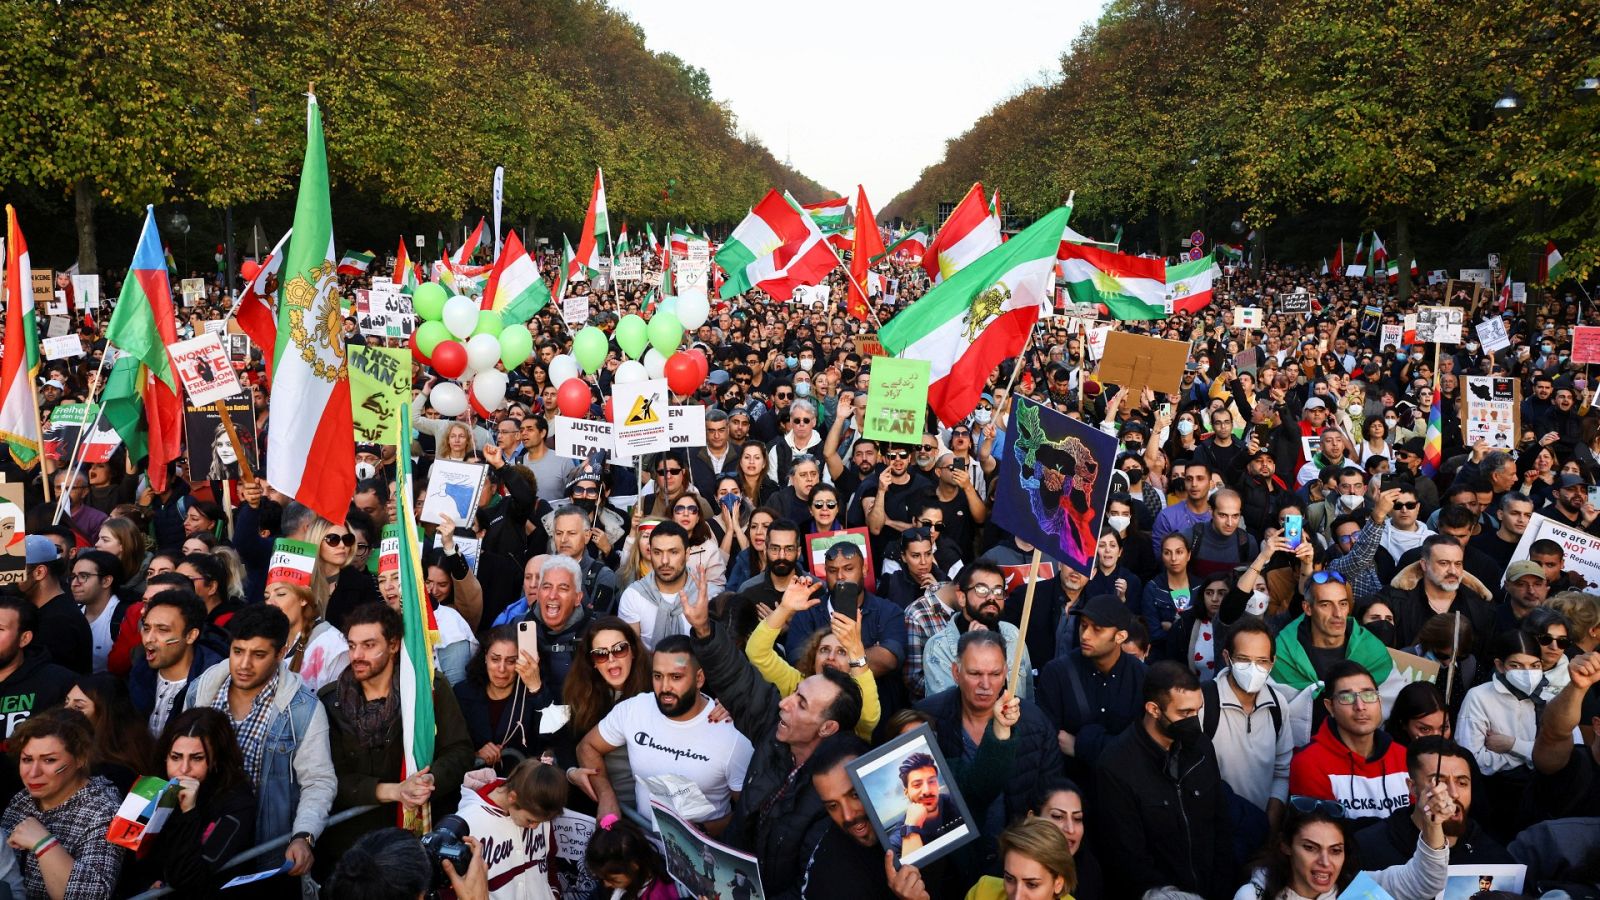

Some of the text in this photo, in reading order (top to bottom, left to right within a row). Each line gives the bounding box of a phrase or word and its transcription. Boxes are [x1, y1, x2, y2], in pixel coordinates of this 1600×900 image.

[174, 343, 221, 363] WOMEN
[362, 346, 400, 373] FREE
[349, 351, 396, 386] IRAN
[881, 407, 916, 419] FREE
[570, 422, 612, 435] JUSTICE
[872, 417, 915, 435] IRAN
[1552, 528, 1567, 537] we
[1569, 534, 1587, 544] are
[1564, 541, 1587, 554] NOT
[634, 731, 710, 762] Champion
[480, 836, 514, 870] New
[570, 847, 583, 856] Iran
